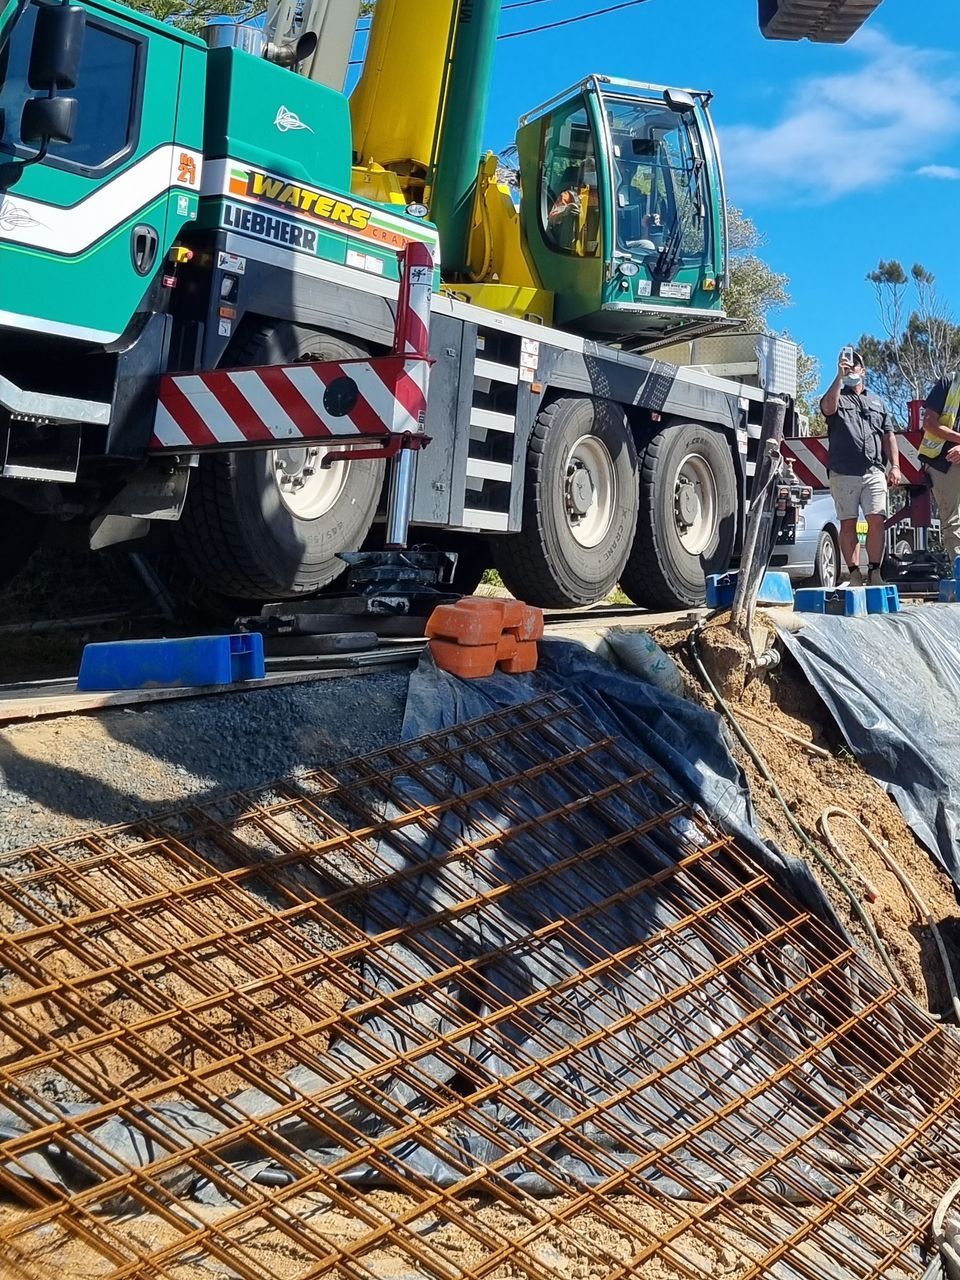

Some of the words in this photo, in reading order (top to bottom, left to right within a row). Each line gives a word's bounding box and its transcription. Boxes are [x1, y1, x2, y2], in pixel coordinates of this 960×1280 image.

[177, 163, 196, 185] 21
[251, 171, 371, 231] WATERS
[223, 202, 318, 251] LIEBHERR
